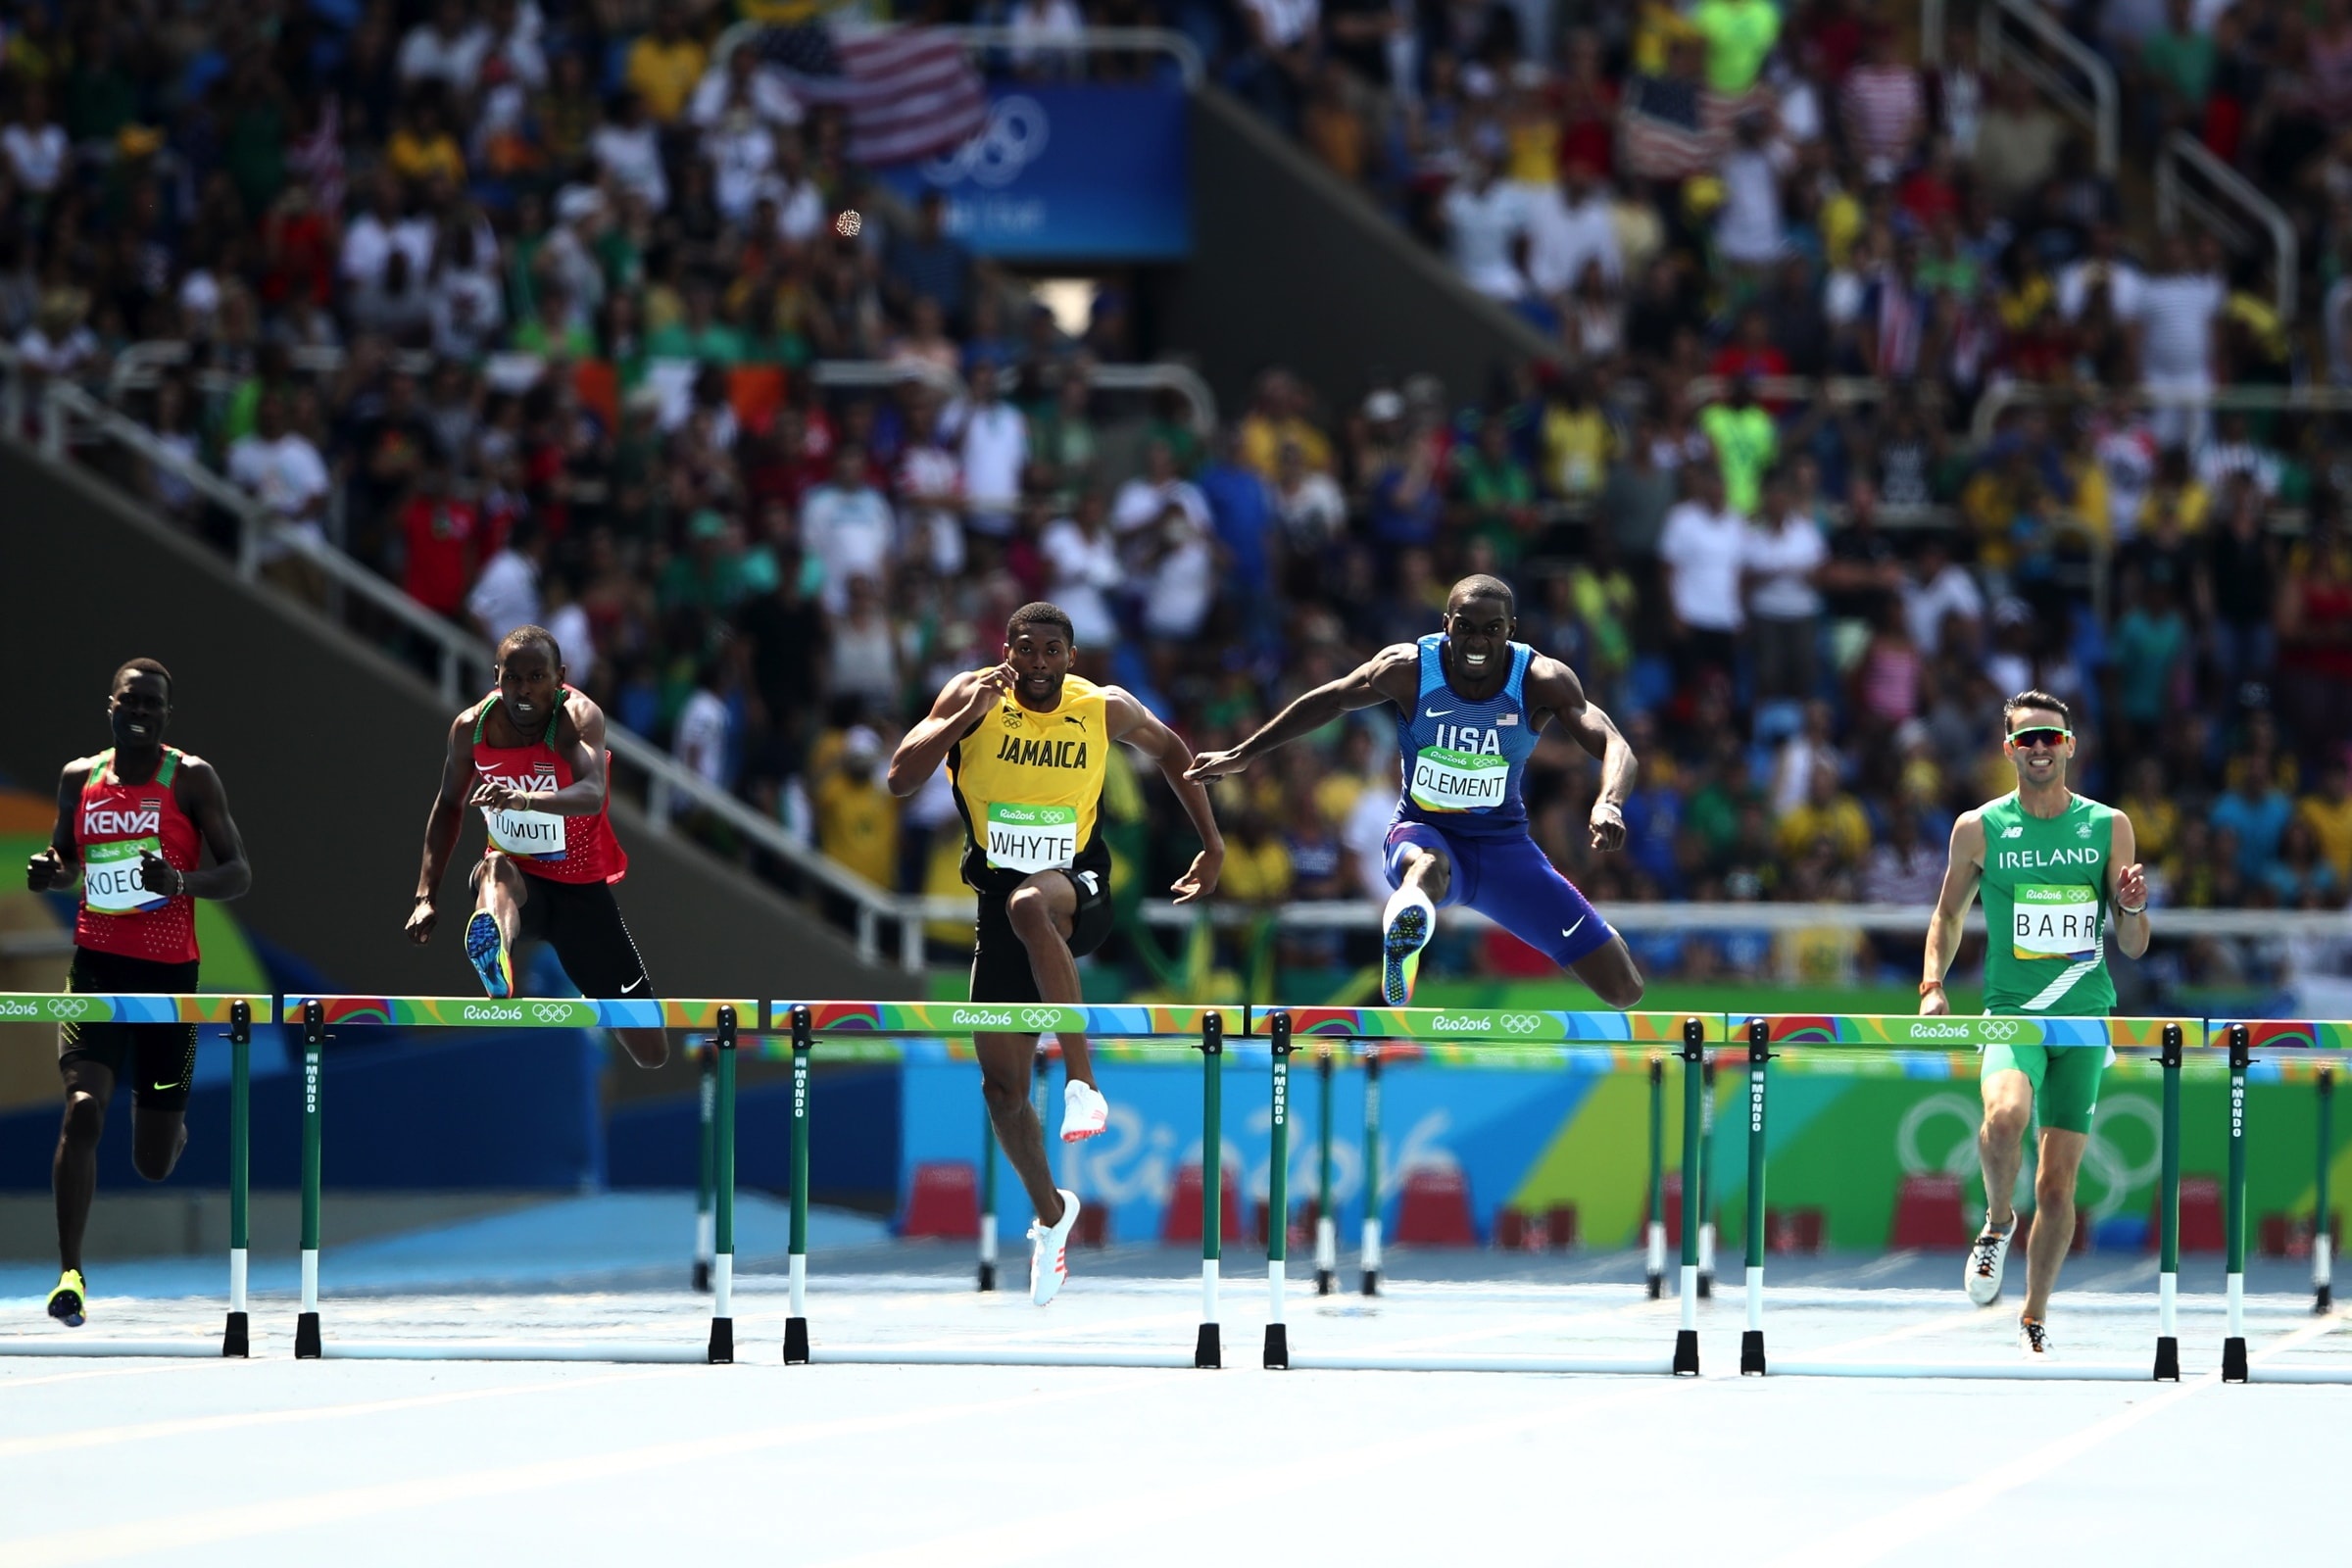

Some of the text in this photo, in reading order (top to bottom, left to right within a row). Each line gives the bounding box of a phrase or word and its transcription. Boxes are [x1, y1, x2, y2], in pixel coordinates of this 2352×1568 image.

[997, 735, 1087, 769] JAMAICA
[1436, 724, 1500, 755] USA
[1416, 765, 1504, 798] CLEMENT
[83, 810, 161, 835] KENYA
[495, 814, 557, 841] TUMUTI
[1000, 808, 1036, 821] Rio2016
[990, 831, 1073, 861] WHYTE
[1998, 848, 2100, 869] IRELAND
[86, 867, 145, 896] KOEC
[2026, 889, 2062, 901] Rio2016
[2017, 913, 2095, 939] BARR
[464, 1004, 523, 1020] Rio2016
[953, 1008, 1012, 1025] Rio2016
[1432, 1015, 1492, 1031] Rio2016
[1910, 1023, 1970, 1038] Rio2016
[306, 1065, 318, 1113] MONDO
[794, 1069, 807, 1117] MONDO
[1273, 1076, 1286, 1125] MONDO
[1751, 1084, 1764, 1132] MONDO
[2231, 1089, 2244, 1138] MONDO
